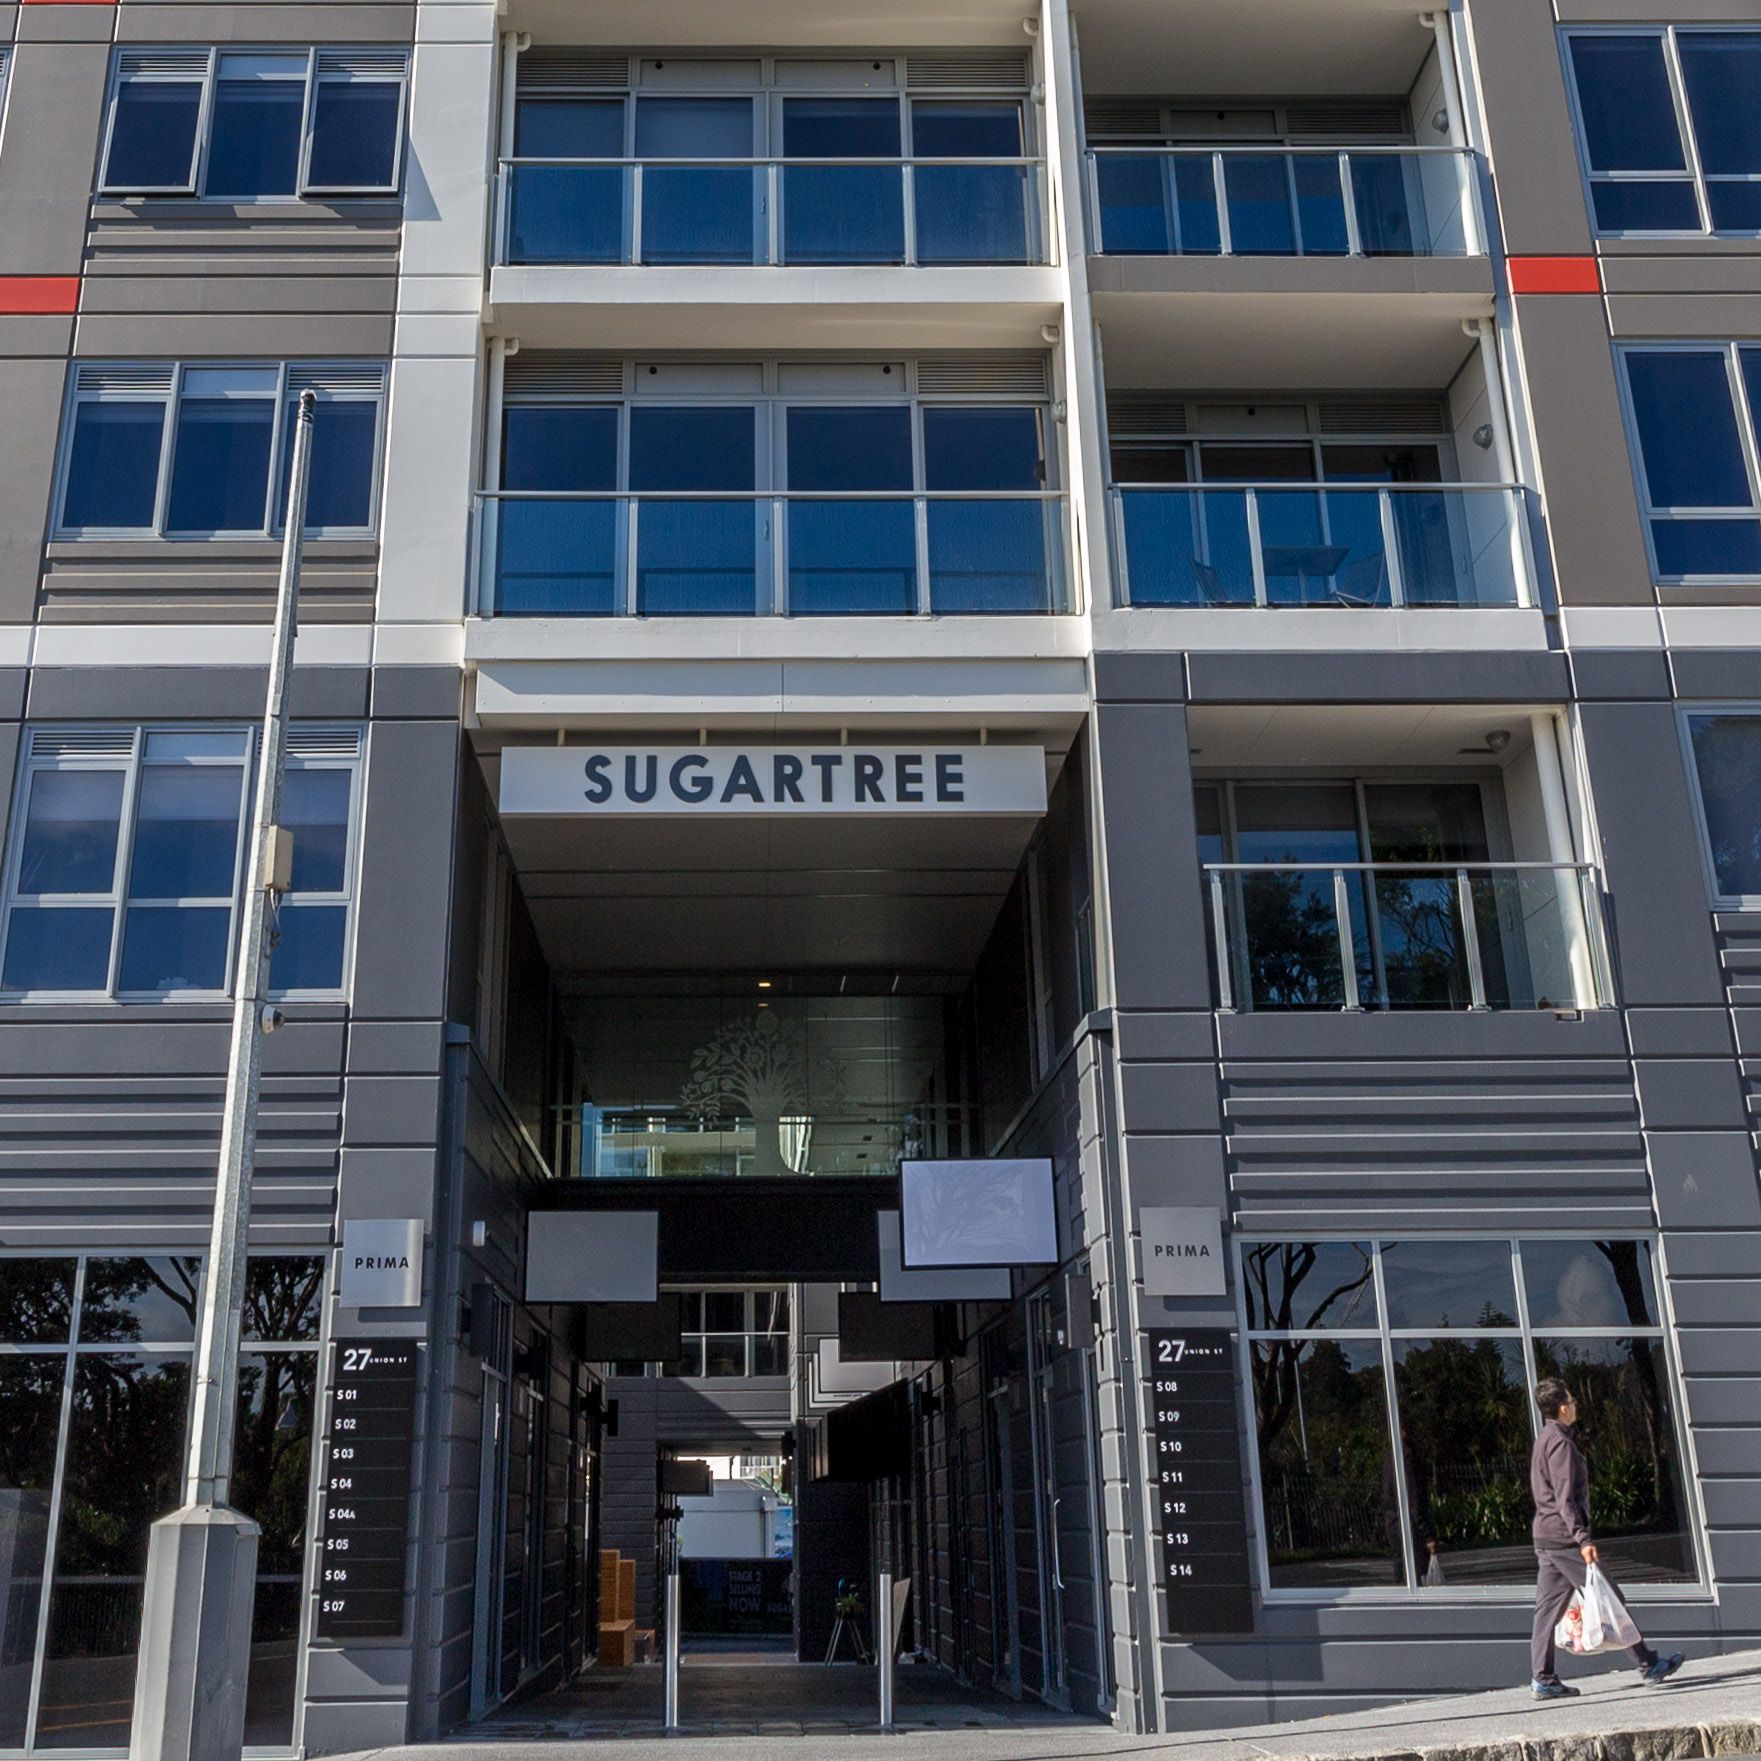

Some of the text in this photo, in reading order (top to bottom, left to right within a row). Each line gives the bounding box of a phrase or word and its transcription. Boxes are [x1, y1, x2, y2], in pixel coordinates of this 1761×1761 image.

[583, 753, 965, 804] SUGARTREE
[1154, 1245, 1210, 1257] PRIMA
[354, 1257, 409, 1269] PRIMA
[1158, 1339, 1185, 1362] 27
[343, 1348, 372, 1371] 27
[1165, 1381, 1177, 1392] 08
[345, 1389, 357, 1400] 01
[1167, 1411, 1180, 1422] 09
[343, 1419, 357, 1430] 02
[1169, 1441, 1182, 1452] 10
[341, 1448, 354, 1459] 03
[1171, 1471, 1183, 1483] 11
[339, 1478, 352, 1489] 04
[1173, 1502, 1186, 1513] 12
[337, 1508, 356, 1519] 04A
[1175, 1533, 1189, 1544] 13
[335, 1539, 349, 1550] 05
[333, 1570, 347, 1581] 06
[1179, 1564, 1192, 1576] 14
[331, 1601, 345, 1612] 07
